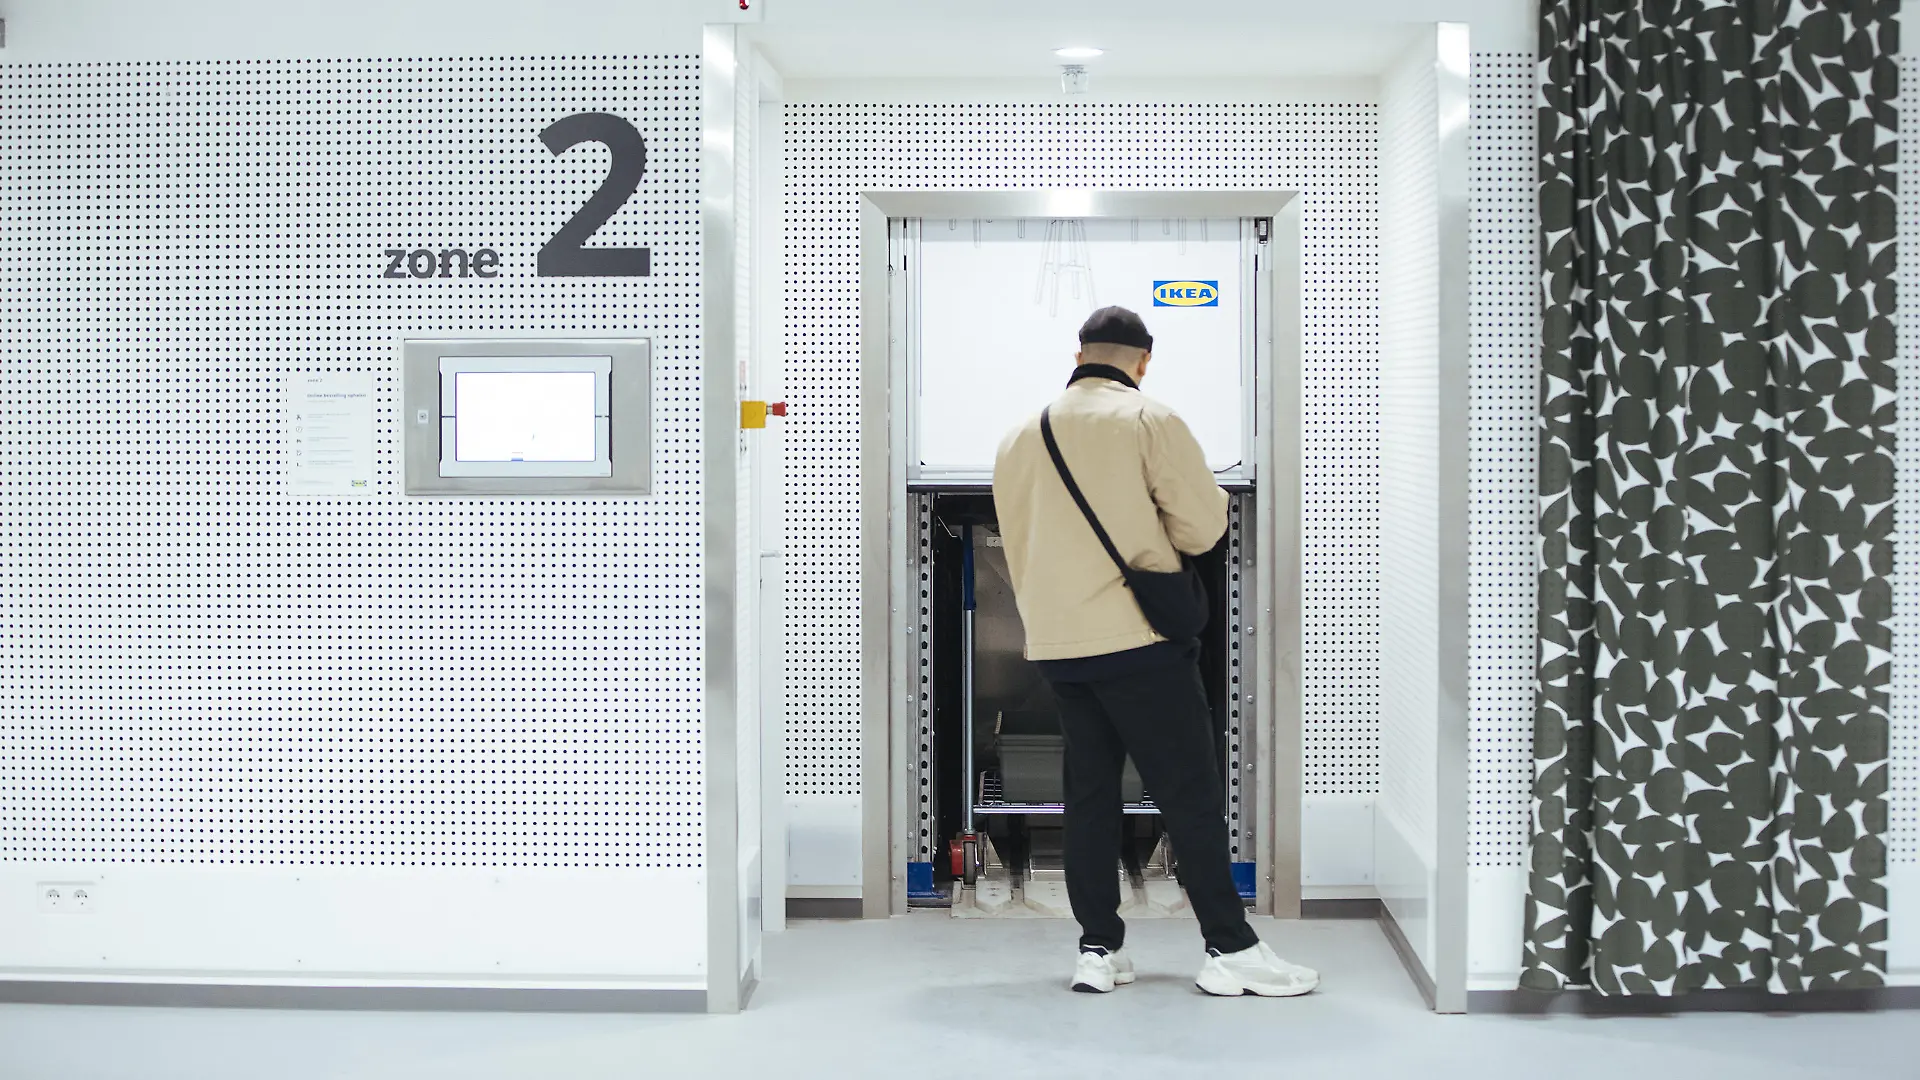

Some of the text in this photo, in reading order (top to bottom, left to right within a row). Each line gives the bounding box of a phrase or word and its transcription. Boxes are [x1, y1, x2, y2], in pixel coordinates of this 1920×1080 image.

[383, 112, 650, 279] zone 2
[1160, 288, 1212, 299] IKEA
